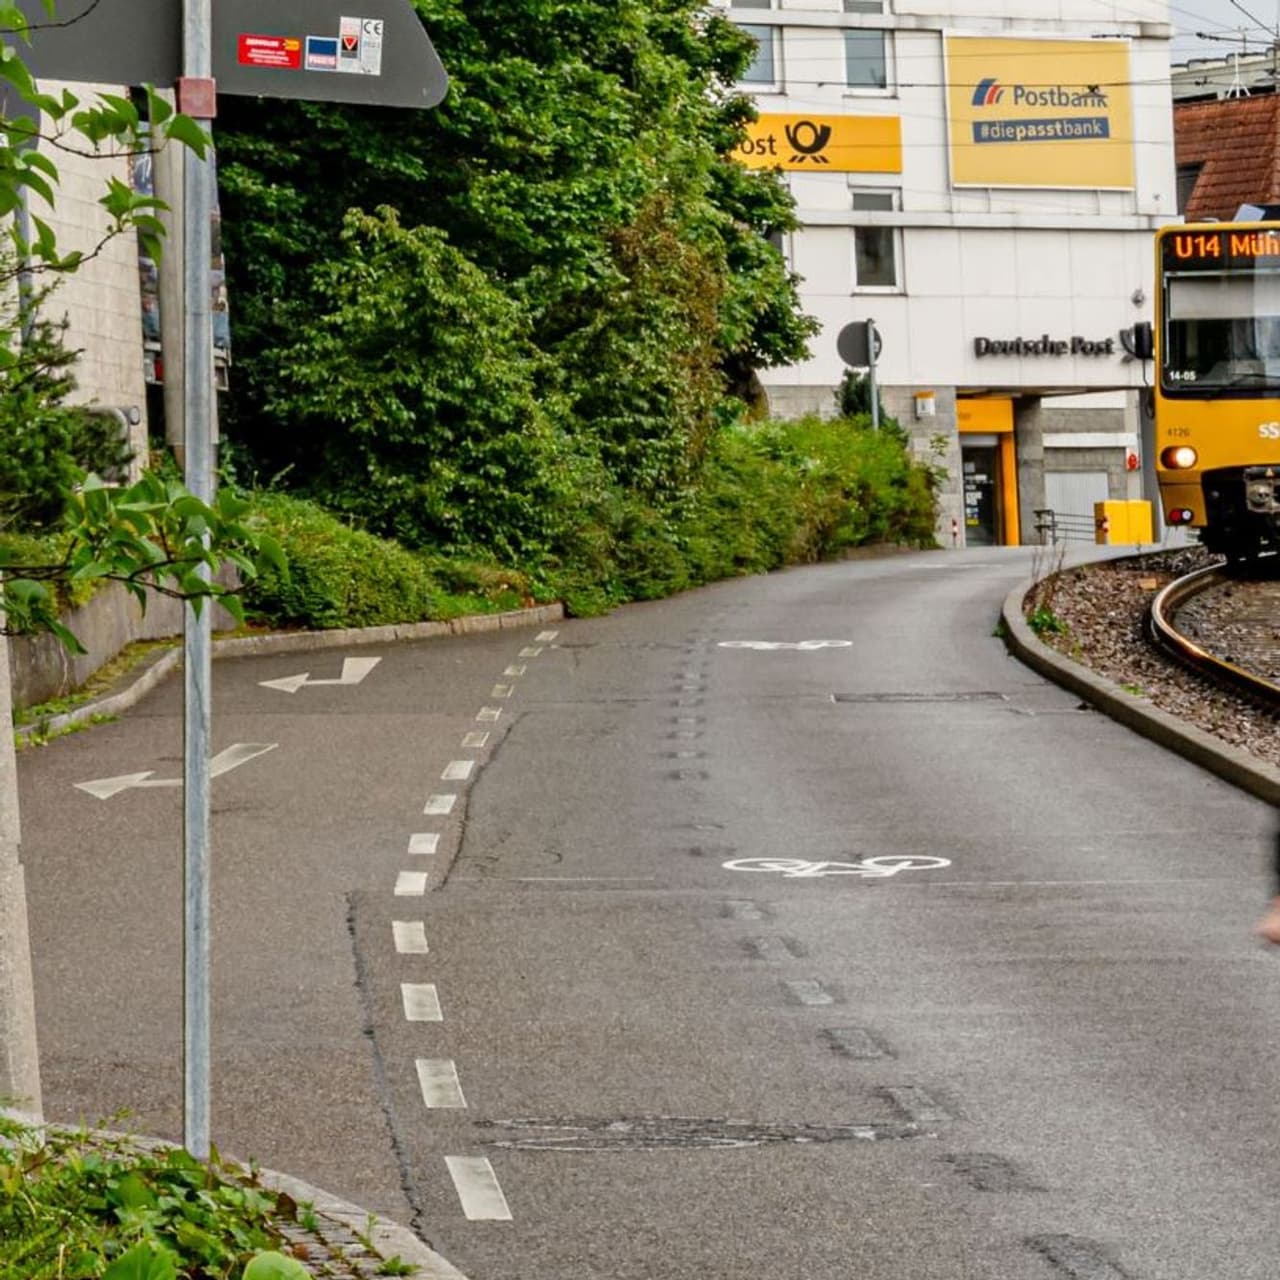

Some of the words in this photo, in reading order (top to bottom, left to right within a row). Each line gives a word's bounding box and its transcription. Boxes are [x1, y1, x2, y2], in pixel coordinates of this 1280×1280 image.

[1013, 84, 1109, 109] Postbank
[980, 119, 1103, 141] #diepasstbank
[735, 134, 777, 156] ost
[1175, 236, 1221, 258] U14
[974, 335, 1069, 358] Deutsche
[1071, 335, 1115, 356] Post
